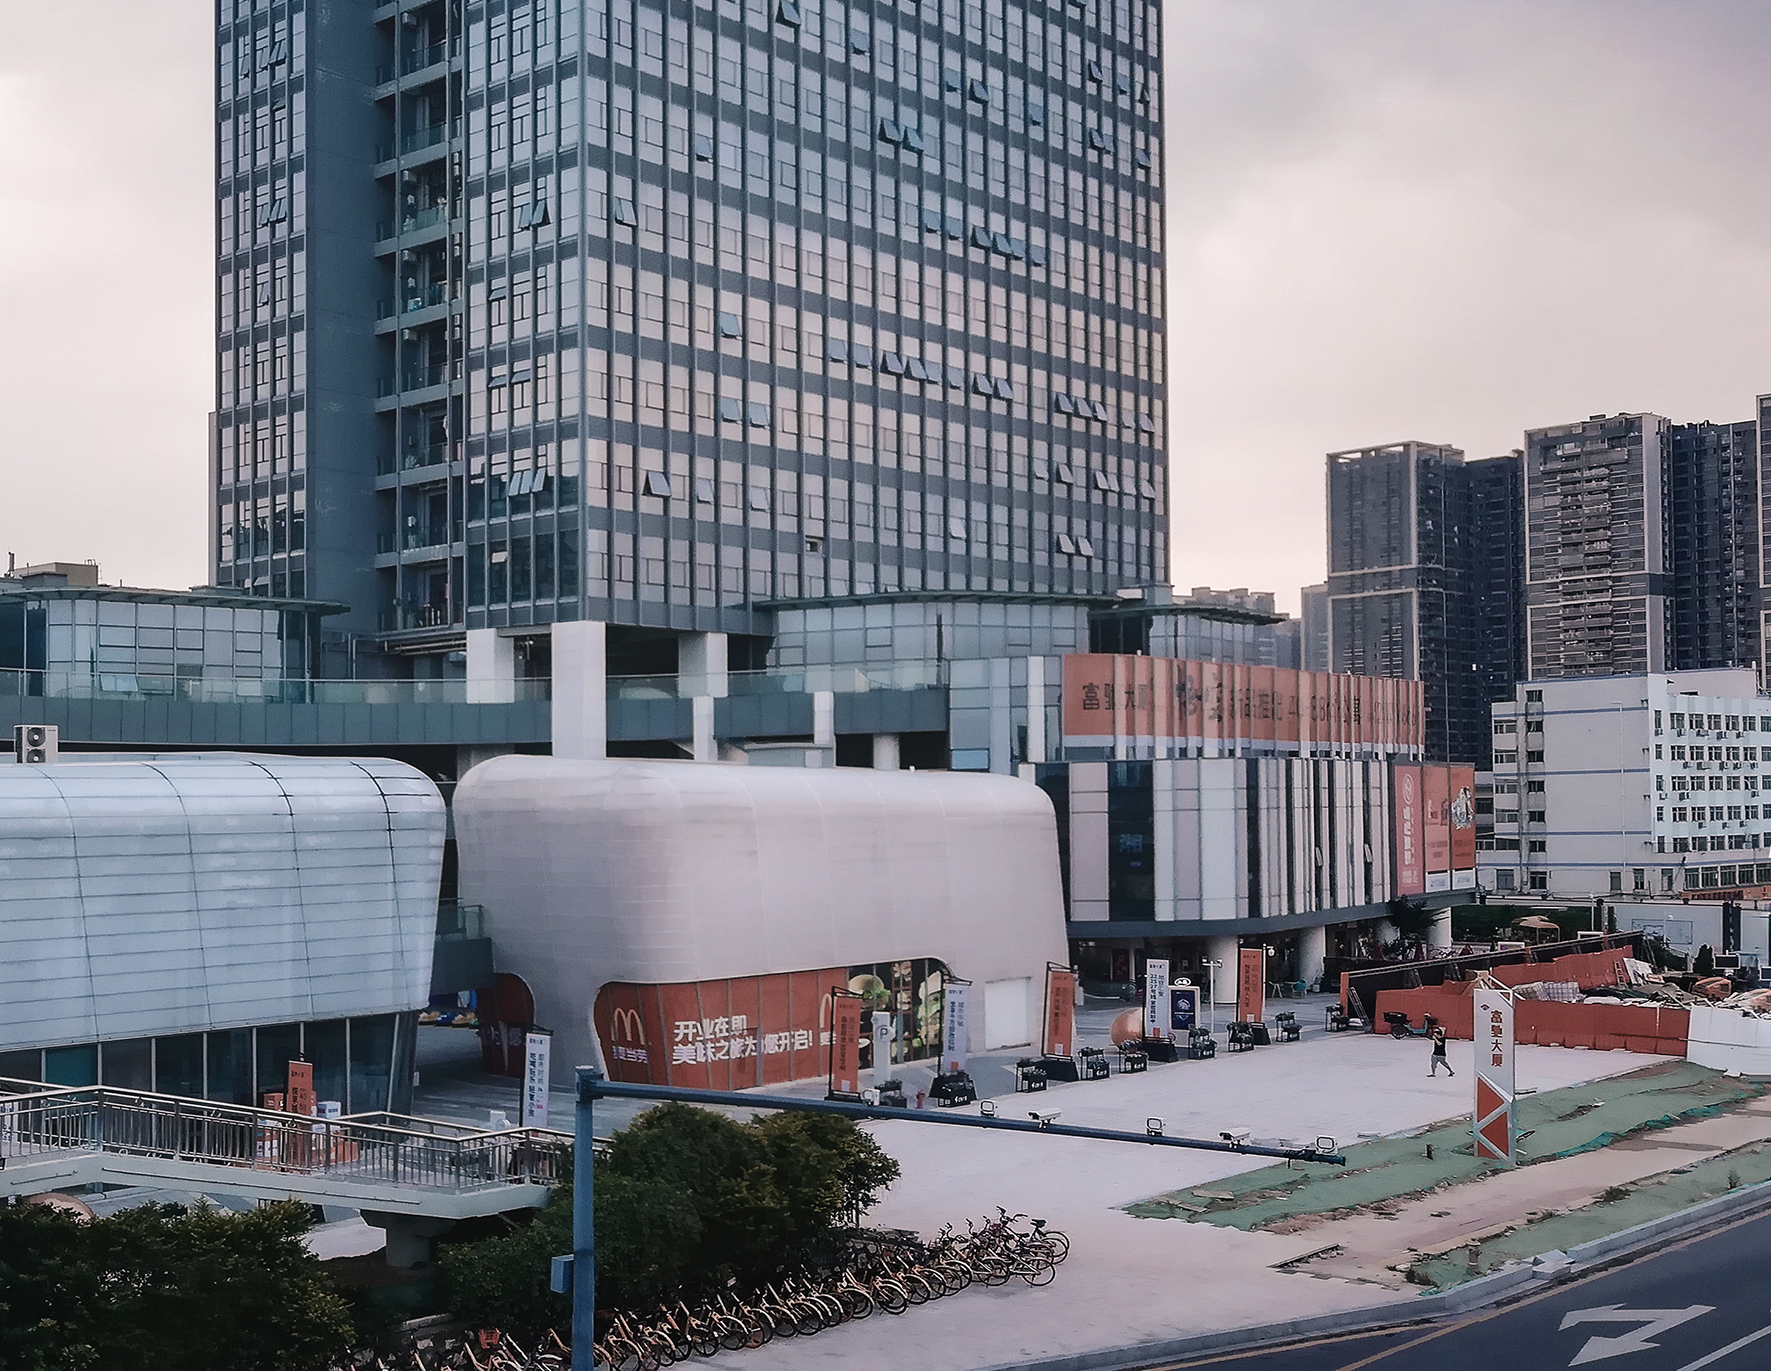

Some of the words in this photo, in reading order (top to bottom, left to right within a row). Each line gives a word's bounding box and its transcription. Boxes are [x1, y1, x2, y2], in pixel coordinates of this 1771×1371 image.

[673, 1014, 747, 1042] 开业在即
[1489, 1009, 1504, 1068] 富驰大厦
